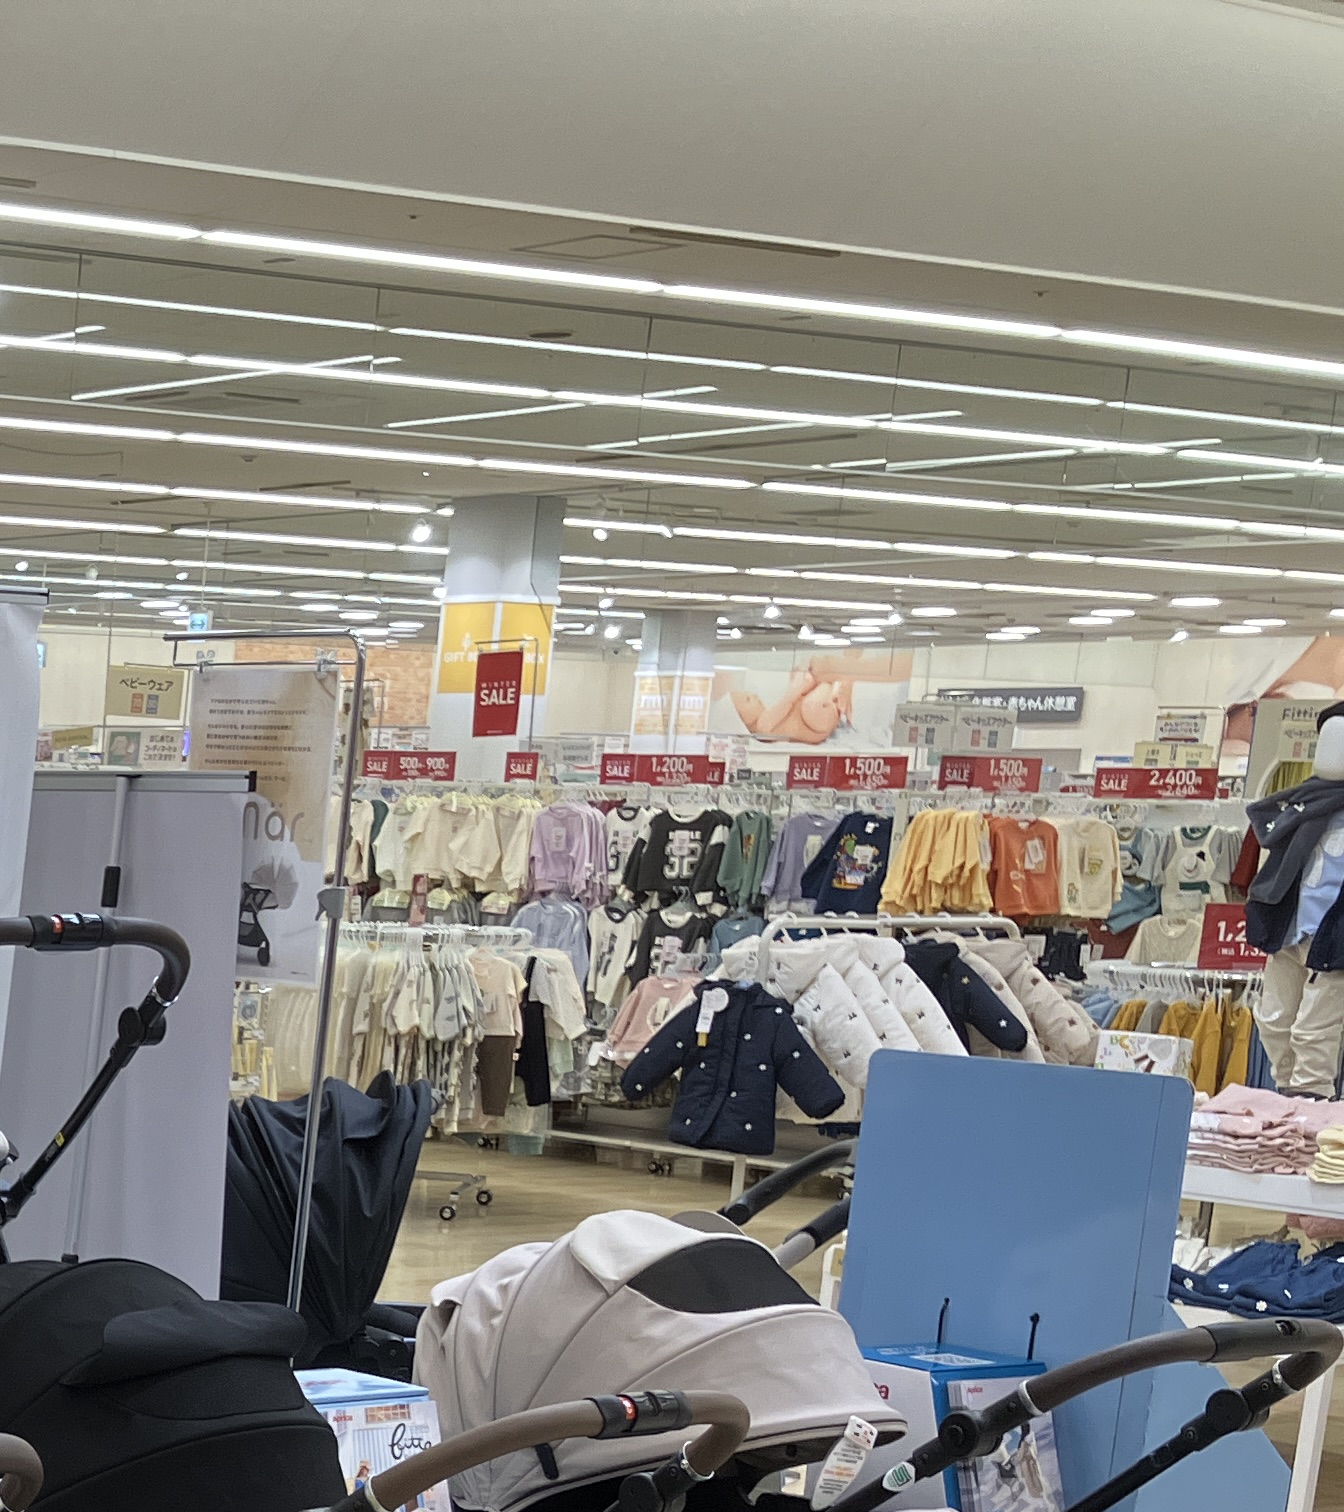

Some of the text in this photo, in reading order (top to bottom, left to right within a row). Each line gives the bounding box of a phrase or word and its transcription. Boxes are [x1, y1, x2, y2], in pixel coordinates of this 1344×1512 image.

[120, 678, 173, 691] ベビーウェア
[480, 688, 515, 706] SALE
[366, 761, 388, 772] SALE
[510, 763, 532, 774] SALE
[606, 765, 630, 777] SALE
[793, 767, 820, 781] SALE
[944, 768, 970, 783] SALE
[1100, 779, 1128, 792] SALE
[242, 801, 305, 842] när
